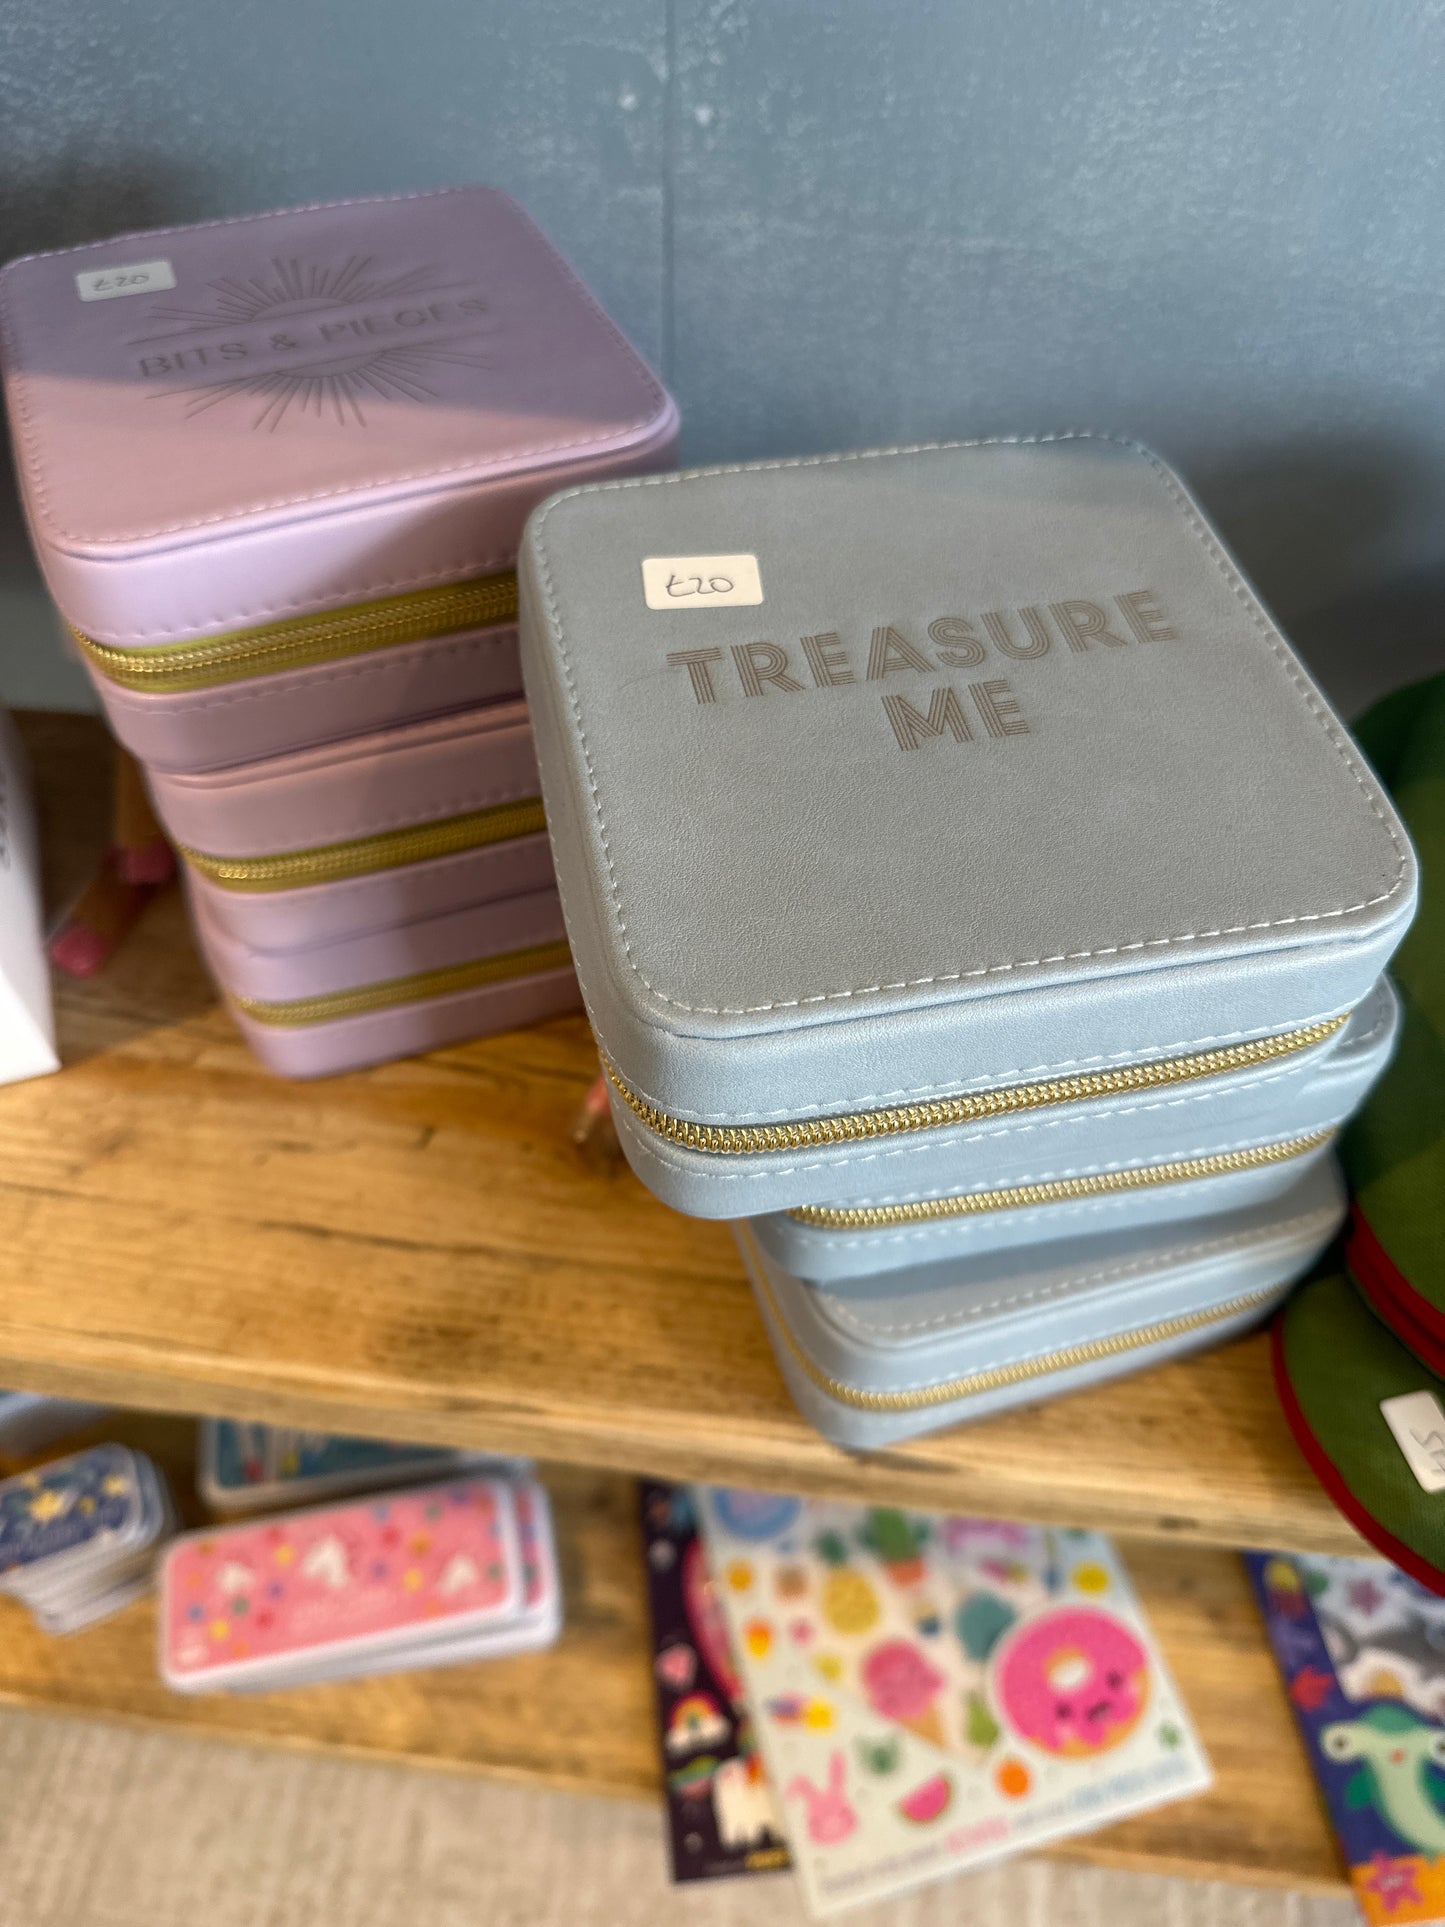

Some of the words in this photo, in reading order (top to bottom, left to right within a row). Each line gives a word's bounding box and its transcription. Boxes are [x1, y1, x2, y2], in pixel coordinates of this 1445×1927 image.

[91, 274, 150, 292] £20
[138, 341, 248, 378] BITS
[268, 331, 298, 351] &
[318, 298, 487, 343] PIECES
[665, 574, 735, 598] £20
[665, 589, 1179, 706] TREASURE
[880, 679, 1031, 752] ME
